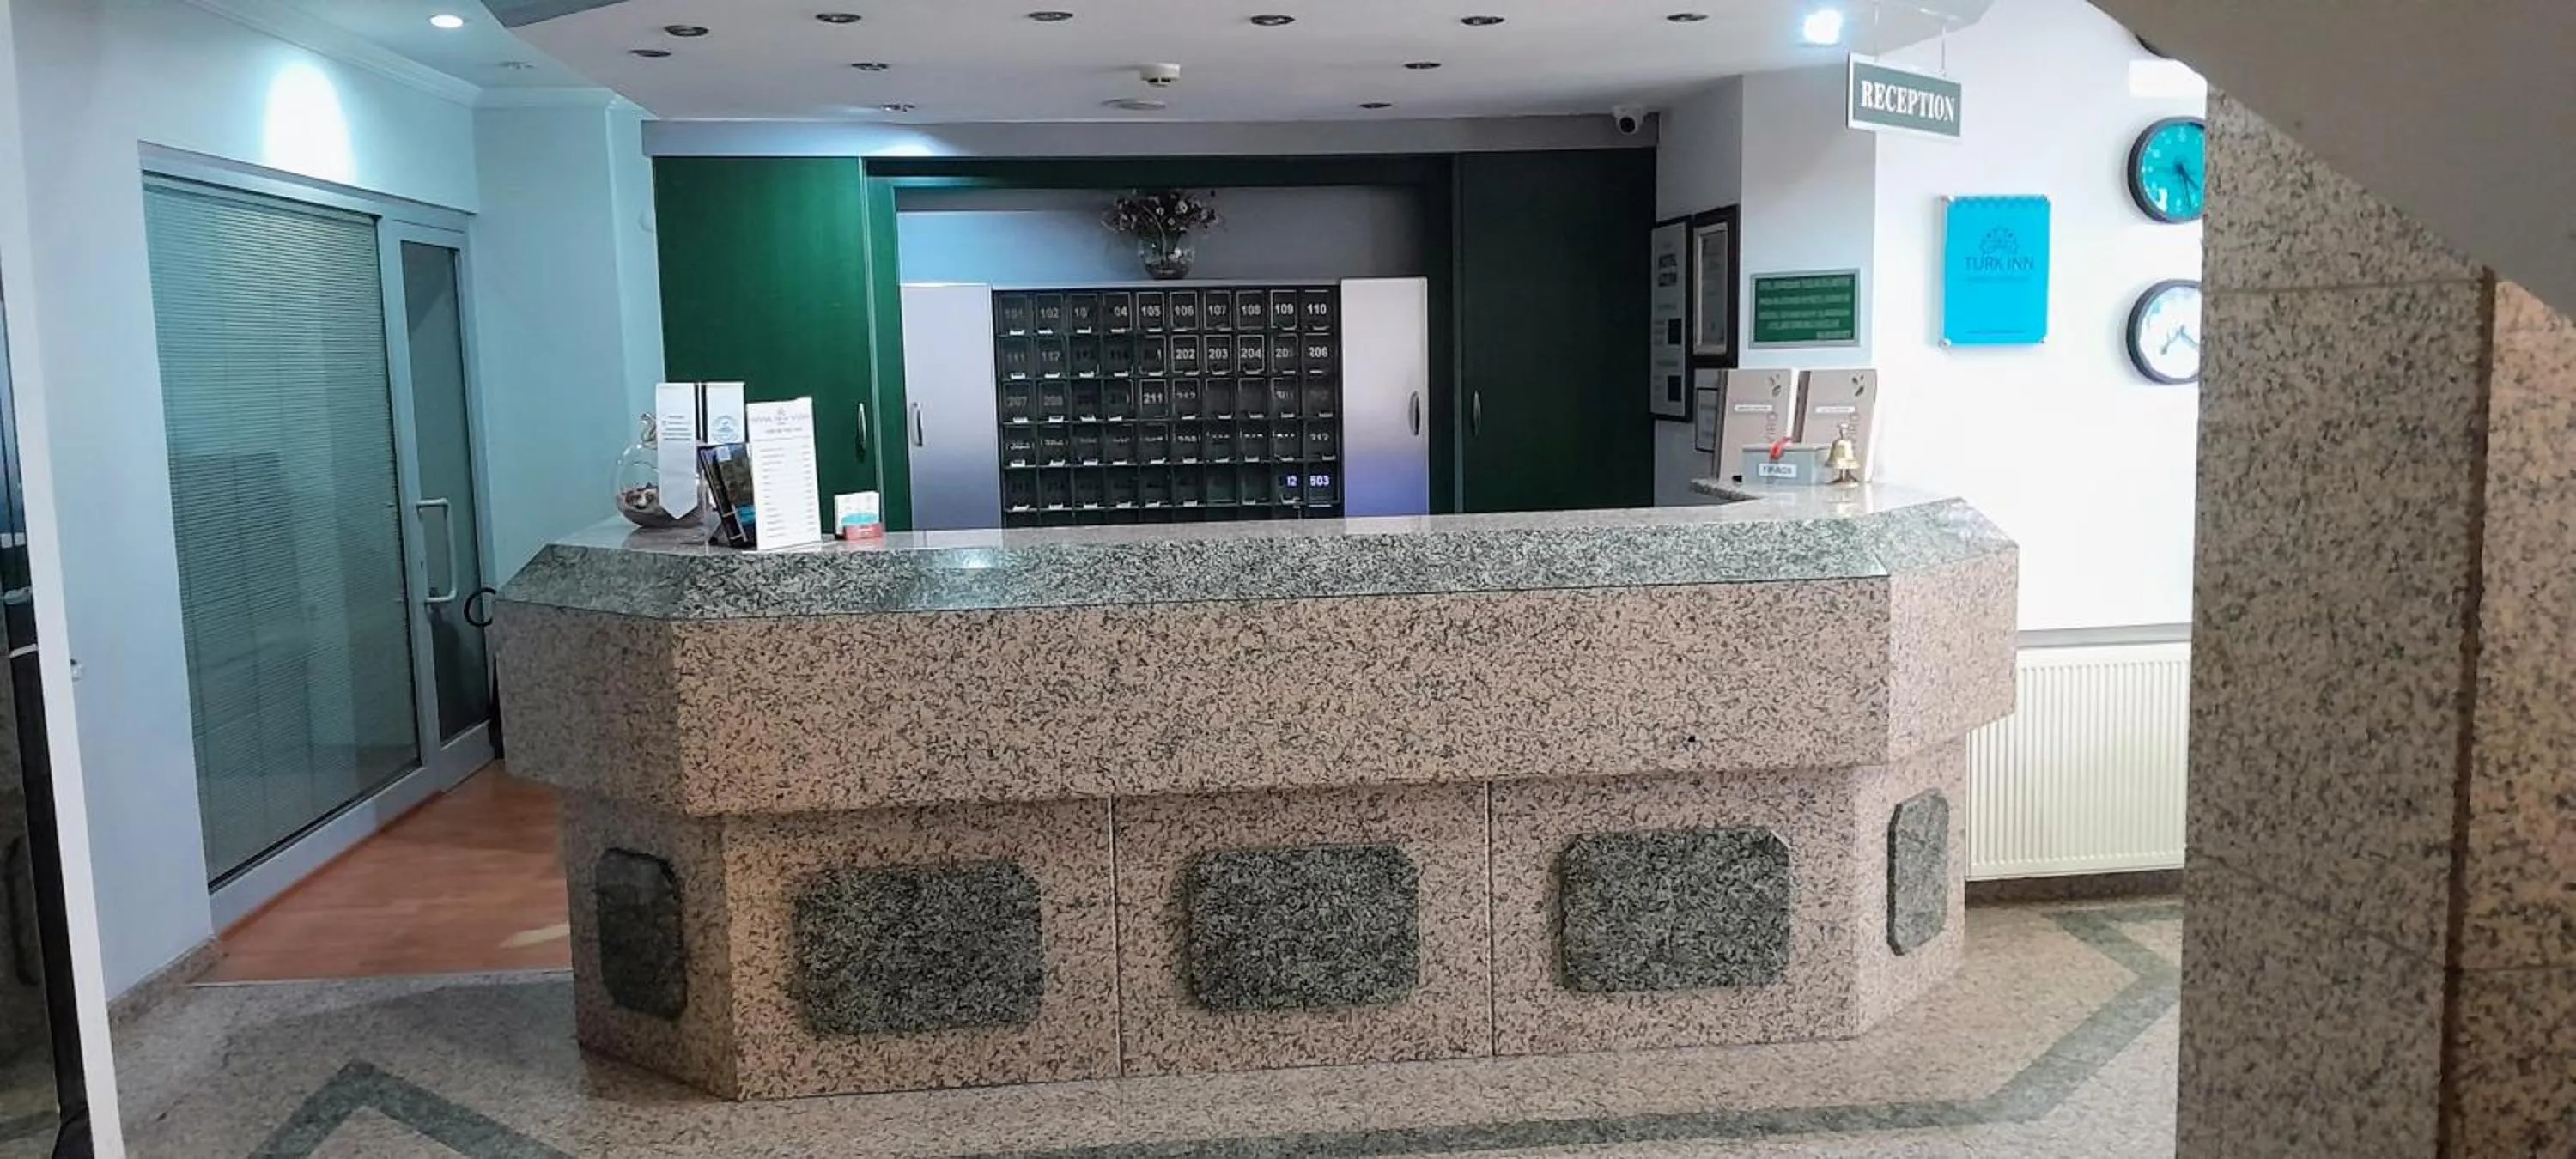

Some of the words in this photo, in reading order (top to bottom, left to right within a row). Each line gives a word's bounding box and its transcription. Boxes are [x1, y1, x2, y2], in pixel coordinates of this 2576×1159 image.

[1860, 80, 1955, 123] RECEPTION
[2008, 256, 2034, 270] INN
[1040, 306, 1060, 319] 102
[1074, 306, 1091, 319] 10
[1140, 304, 1162, 317] 105
[1174, 304, 1194, 317] 106
[1208, 304, 1227, 316] 107
[1274, 302, 1294, 316] 109
[1306, 302, 1327, 316] 110
[1175, 348, 1196, 361] 202
[1208, 348, 1229, 361] 203
[1241, 347, 1261, 360] 204
[1143, 391, 1163, 405] 211
[1309, 474, 1330, 488] 503
